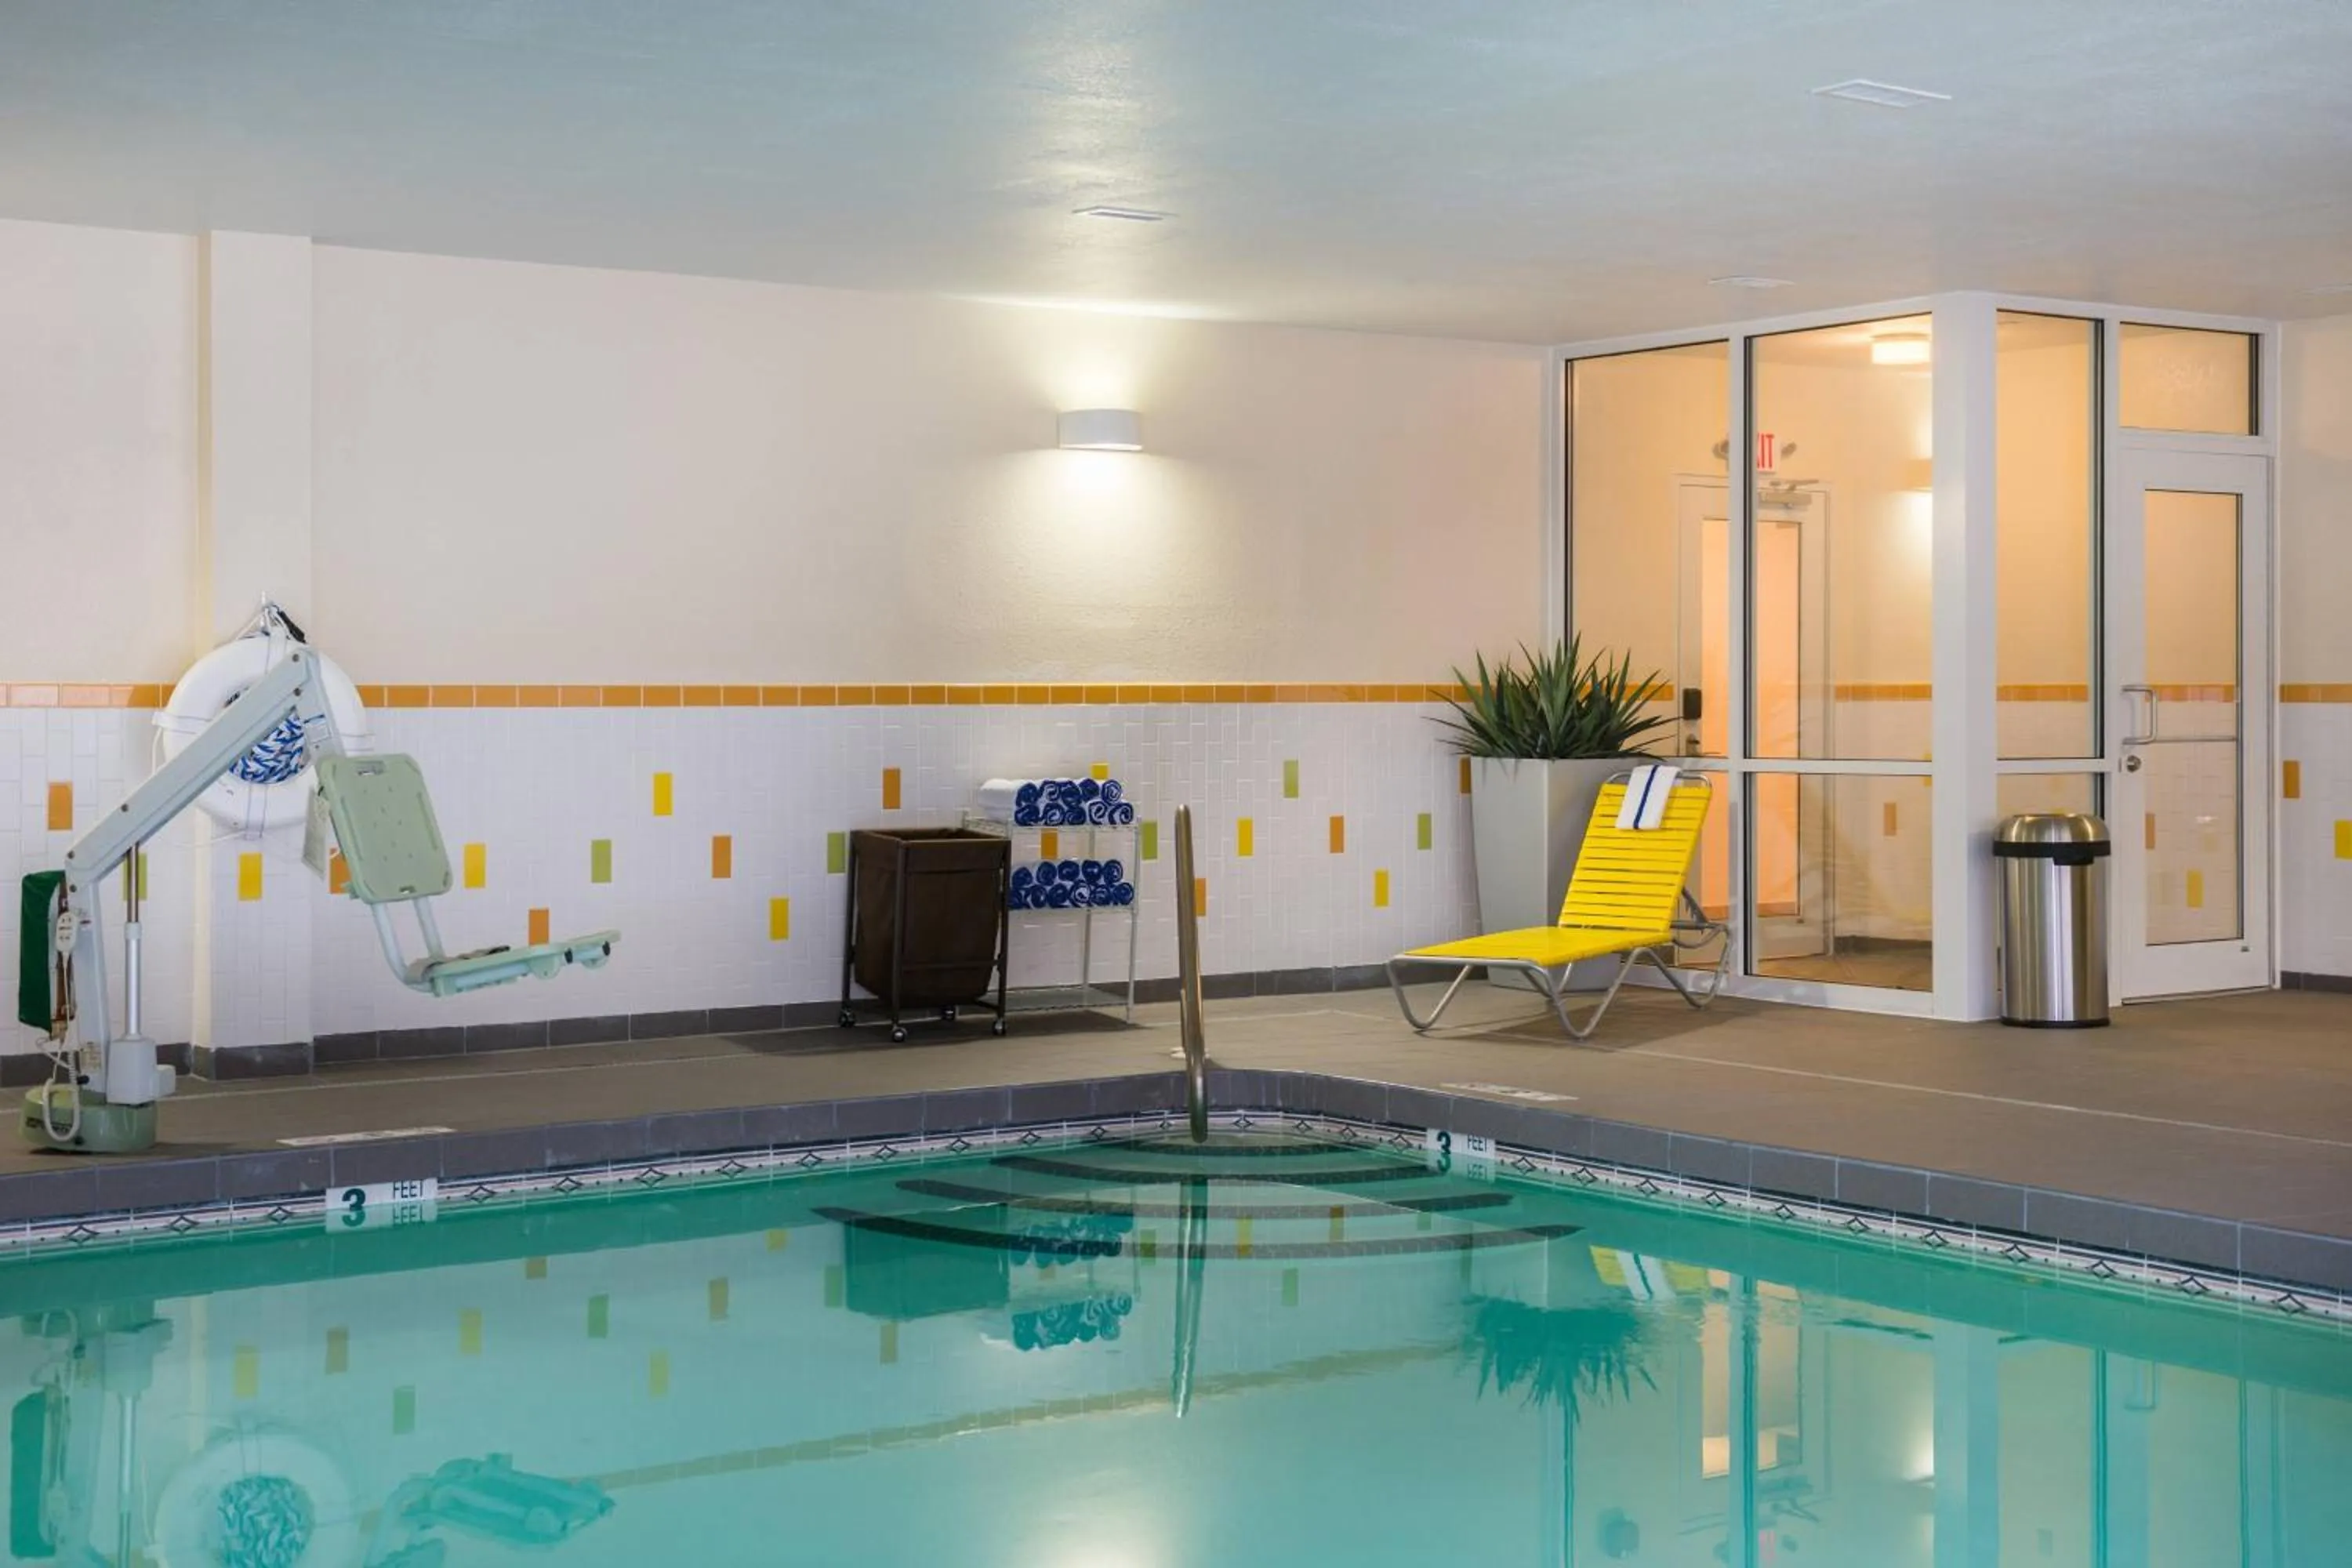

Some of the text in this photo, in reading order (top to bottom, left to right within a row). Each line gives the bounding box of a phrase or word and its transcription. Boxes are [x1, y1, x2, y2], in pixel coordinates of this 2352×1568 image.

[1756, 433, 1774, 469] IT
[1437, 1131, 1487, 1154] 3 FEET
[342, 1179, 423, 1211] 3 FEET
